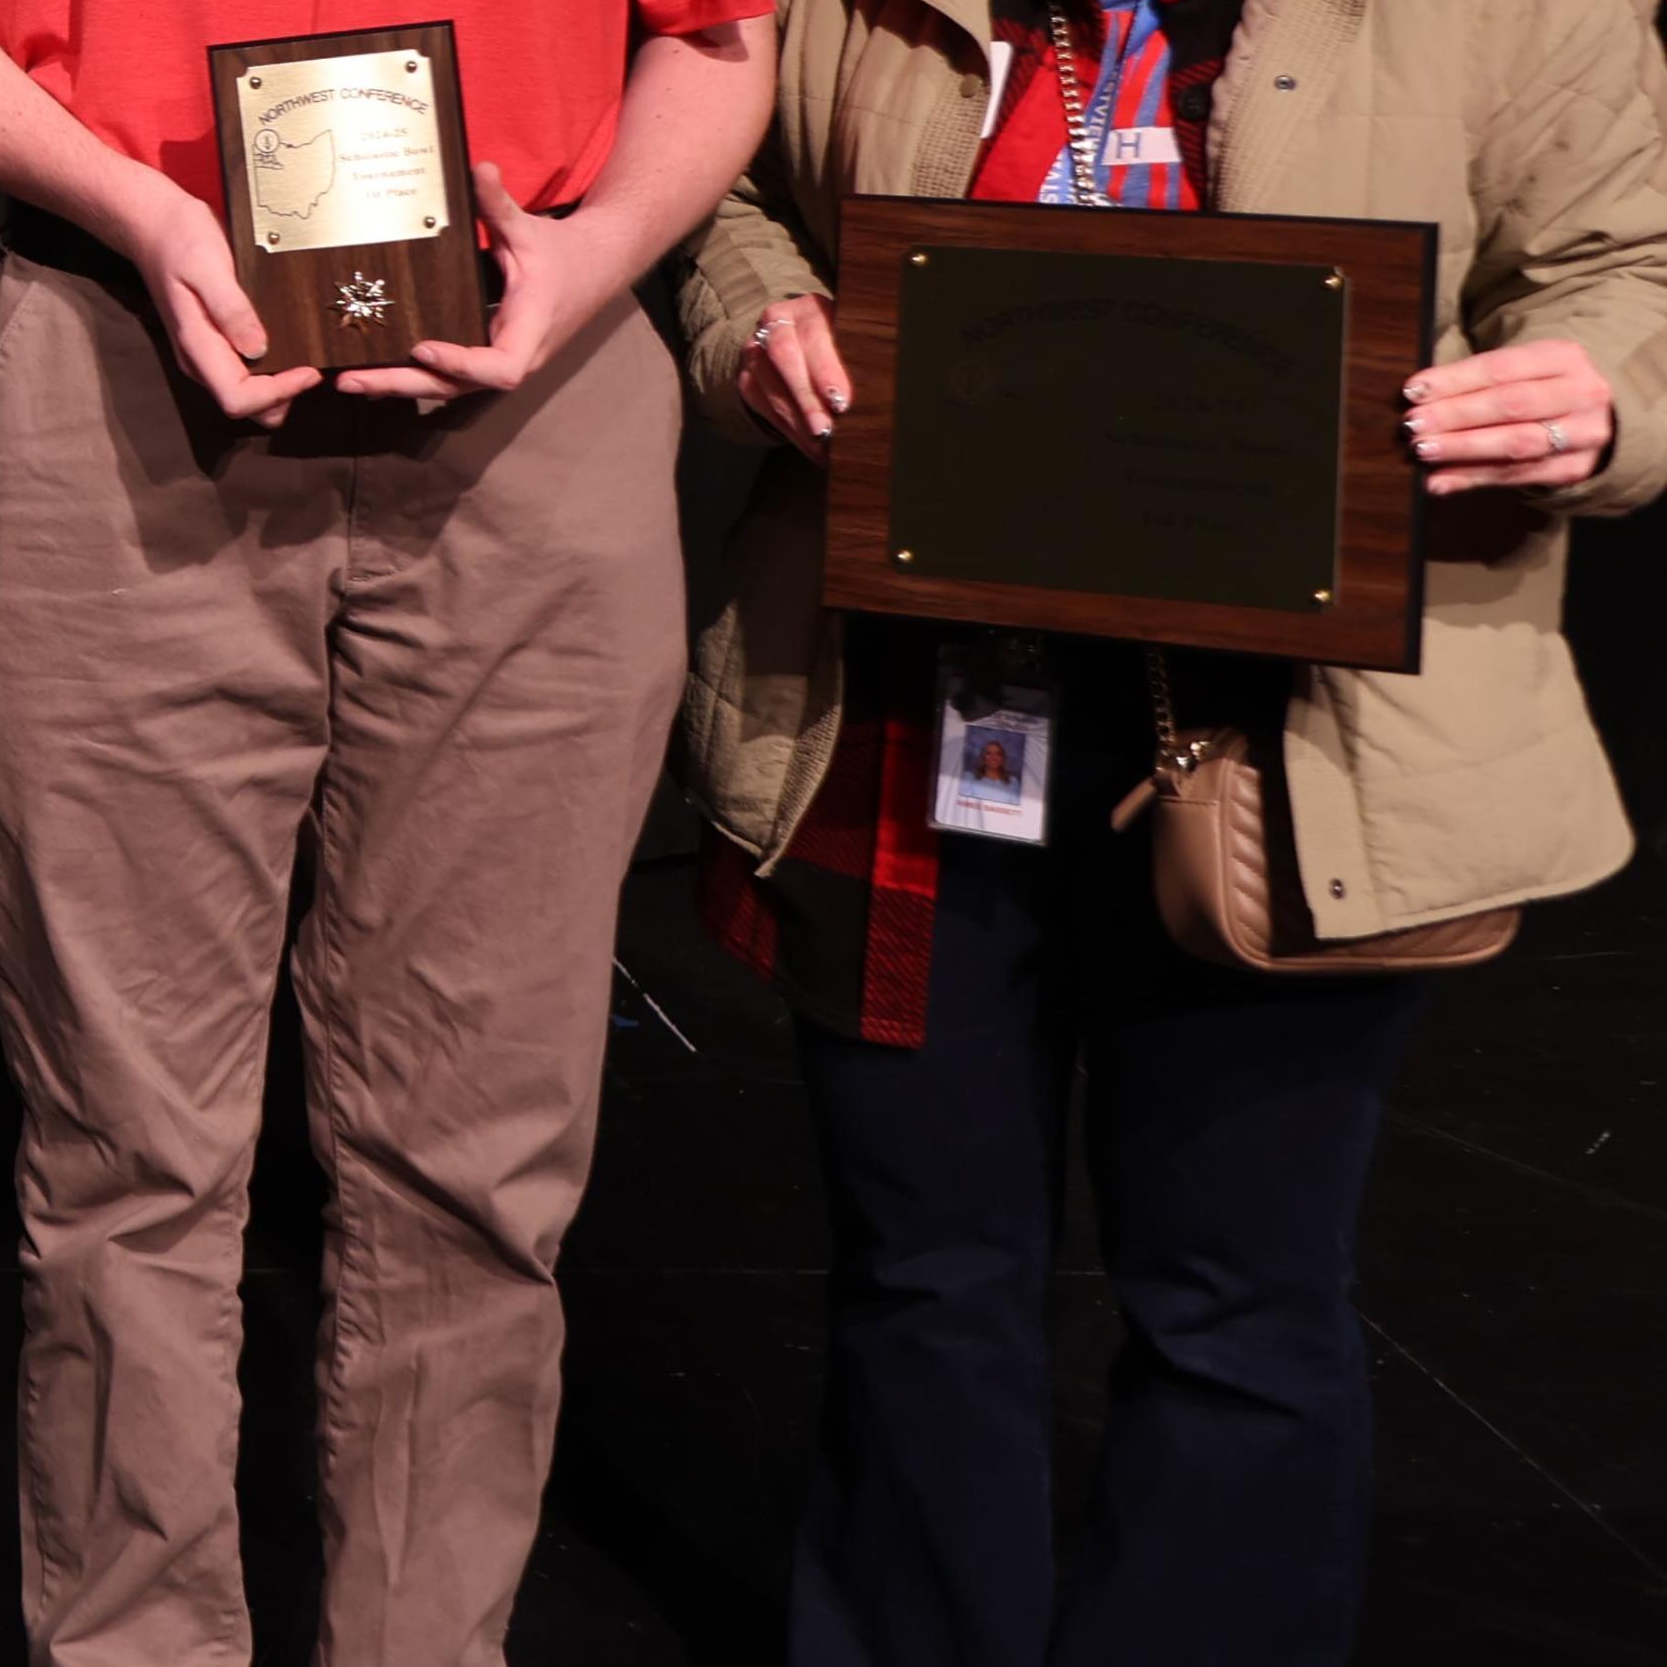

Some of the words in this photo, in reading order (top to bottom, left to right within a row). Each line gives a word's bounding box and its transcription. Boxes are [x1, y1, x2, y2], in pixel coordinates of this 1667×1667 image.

[259, 89, 335, 126] NORTHWEST
[340, 88, 429, 115] CONFERENCE
[404, 146, 435, 156] Bowl
